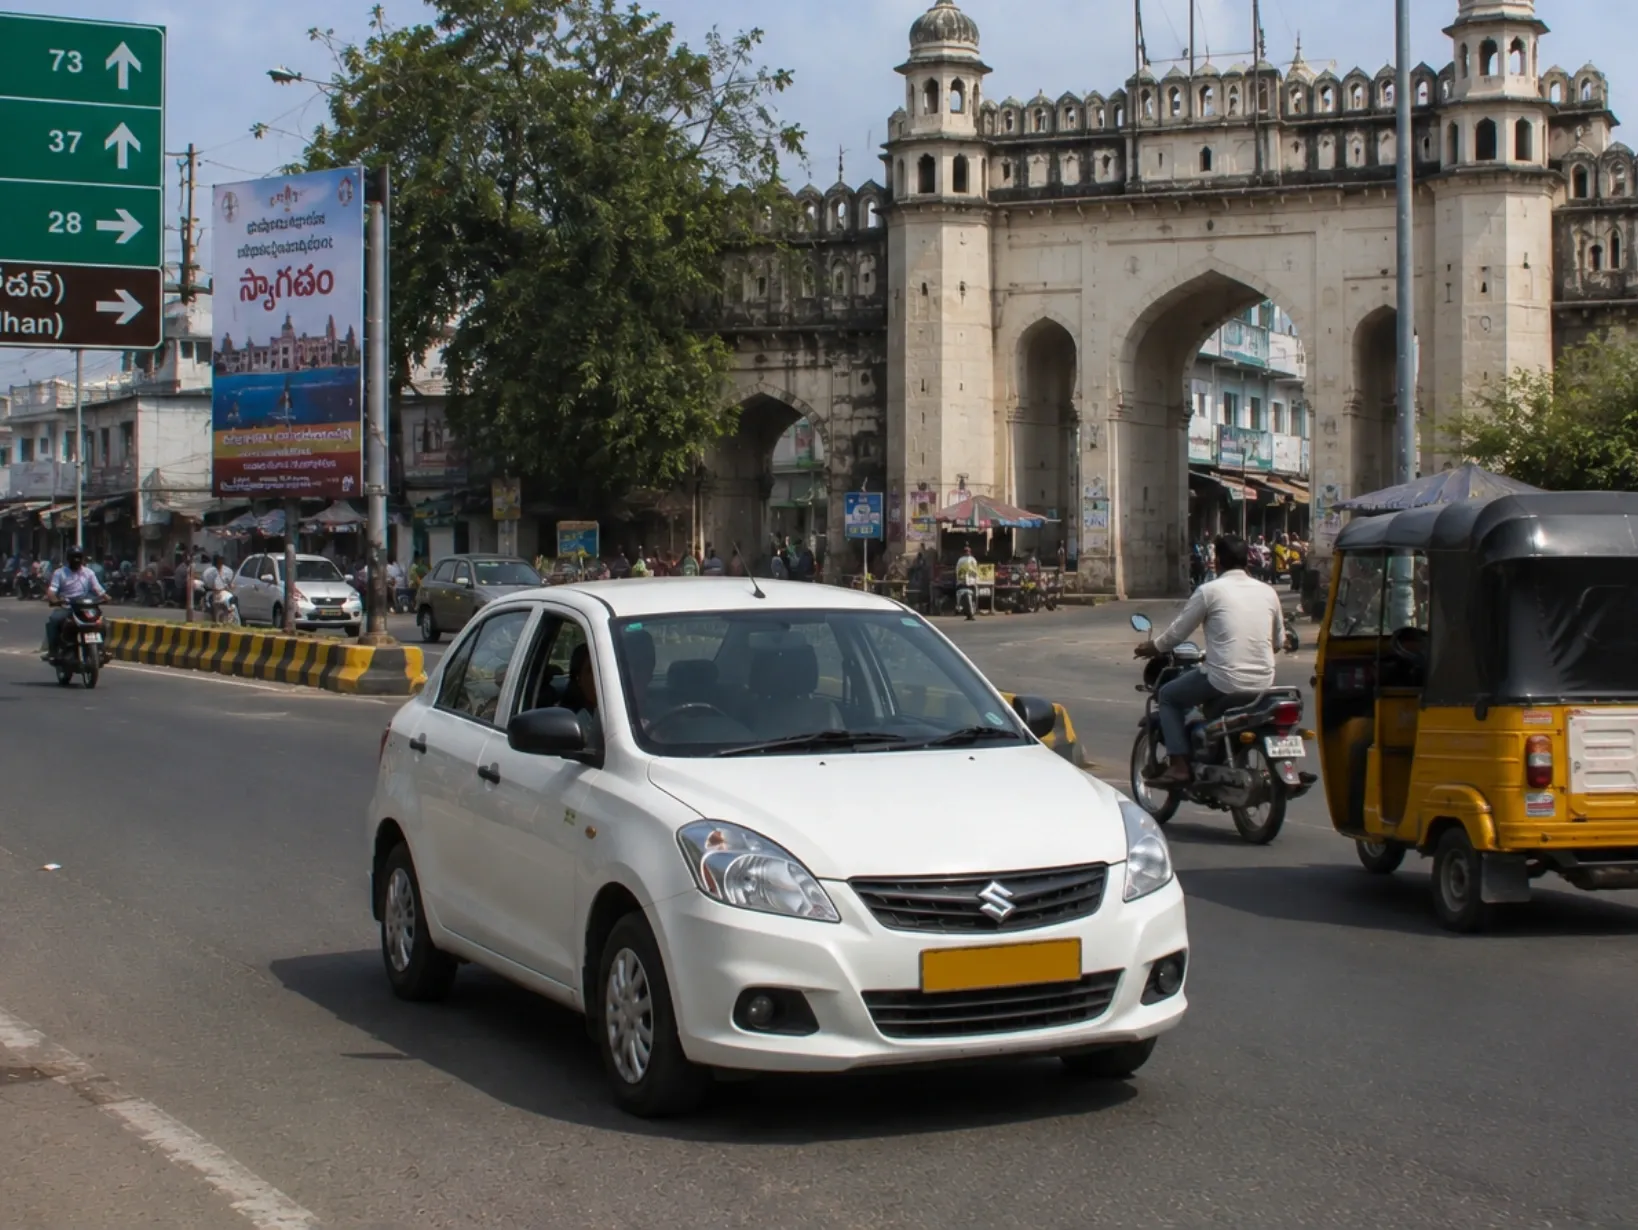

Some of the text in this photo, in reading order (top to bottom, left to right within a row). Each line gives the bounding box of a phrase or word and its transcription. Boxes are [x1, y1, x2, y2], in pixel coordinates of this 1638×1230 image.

[48, 48, 83, 73] 73
[48, 129, 82, 153] 37
[48, 210, 82, 234] 28
[0, 310, 64, 339] han)
